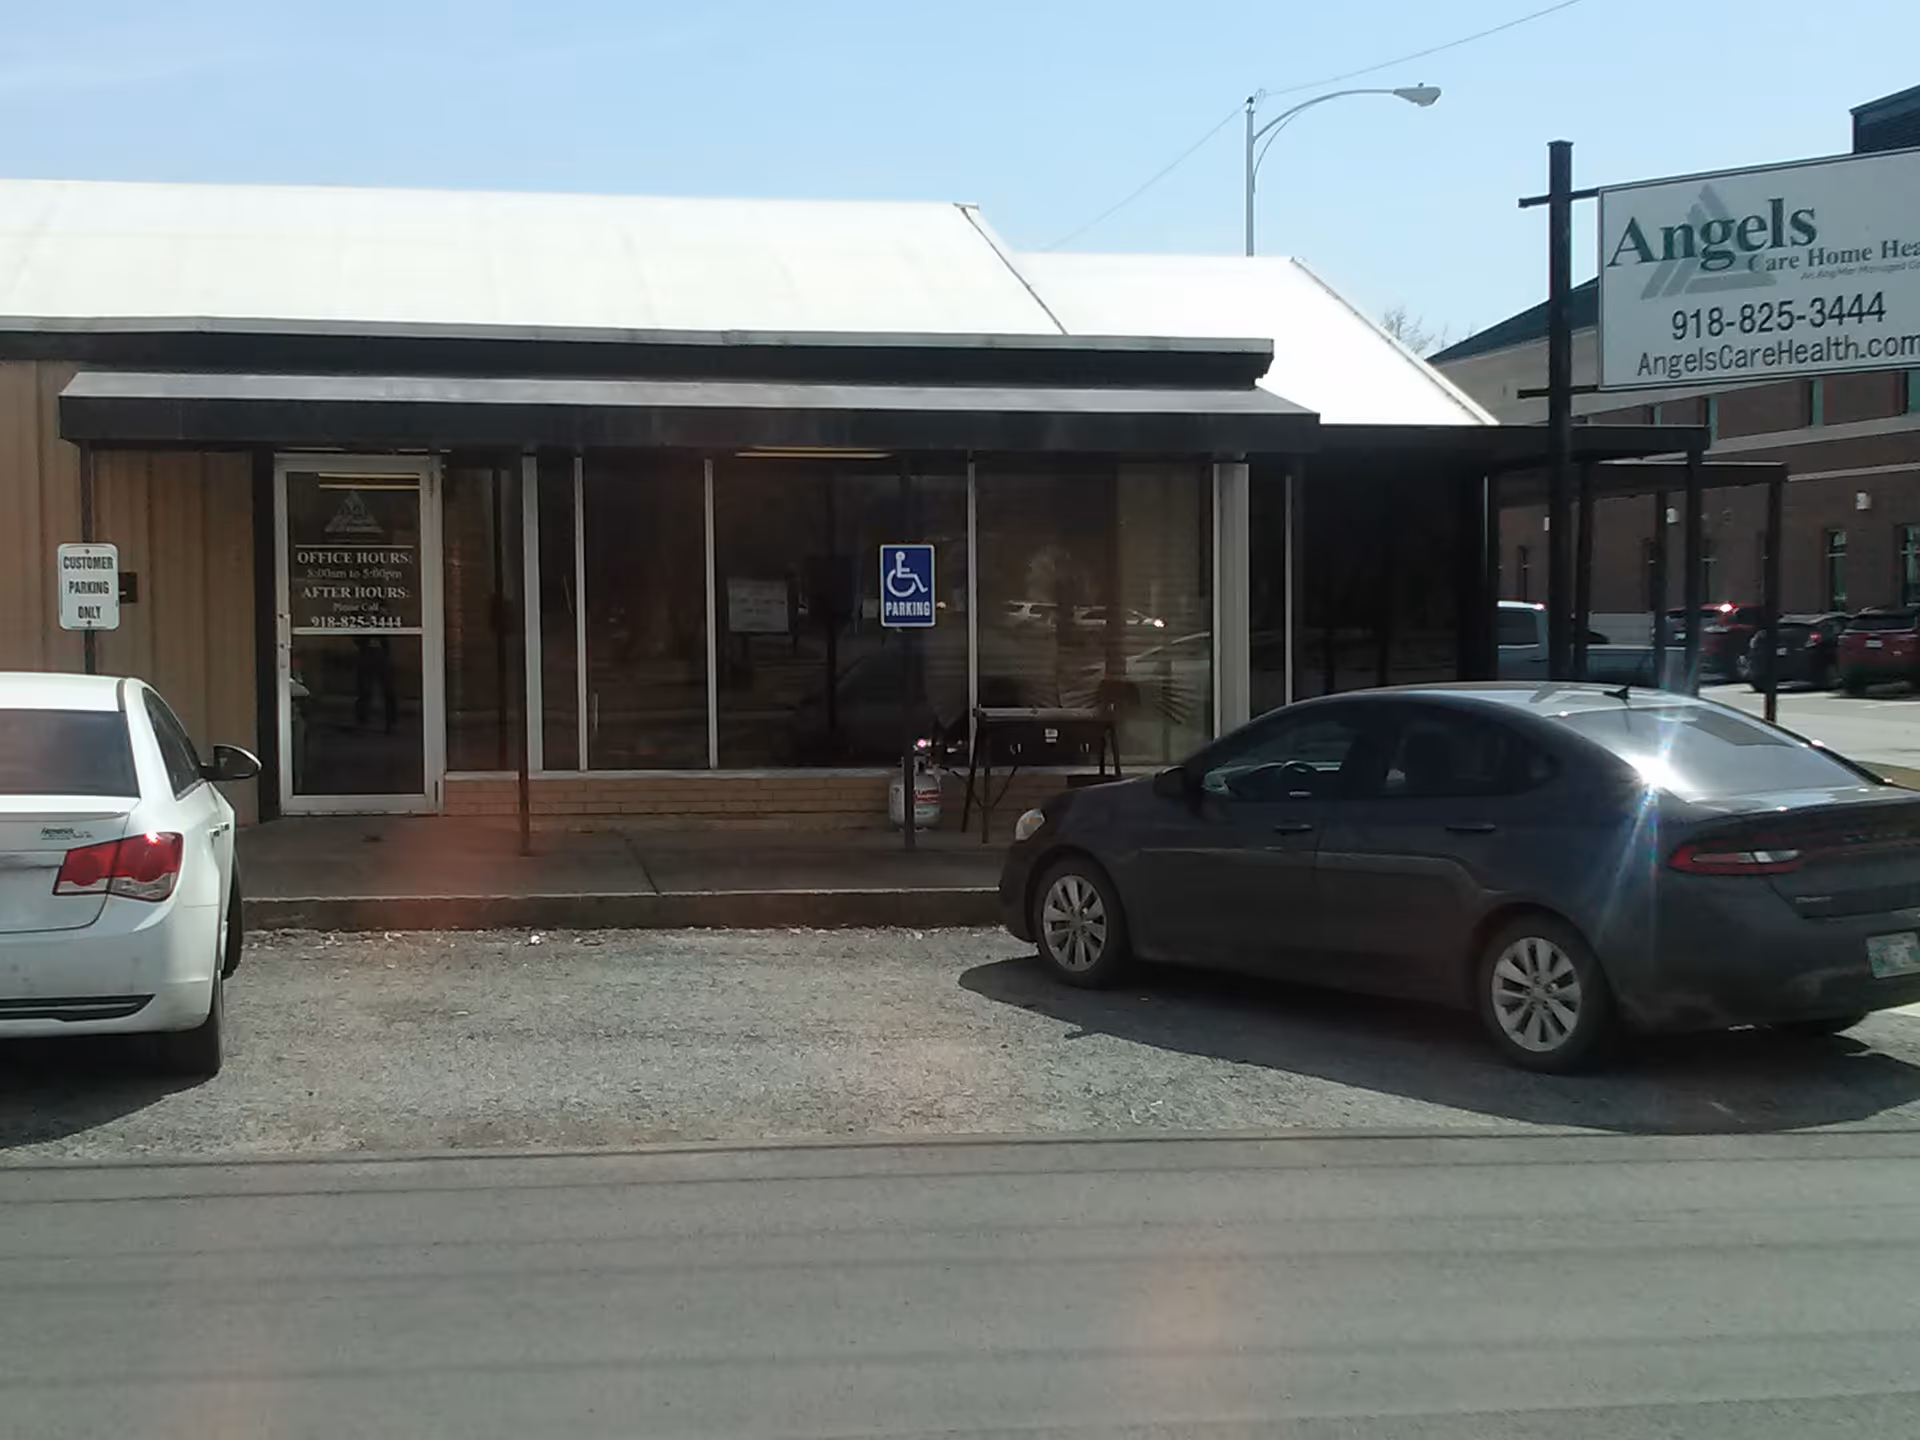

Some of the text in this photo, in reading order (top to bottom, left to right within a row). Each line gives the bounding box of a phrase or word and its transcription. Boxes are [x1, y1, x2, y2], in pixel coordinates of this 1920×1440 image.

[1606, 197, 1818, 272] Angels
[1747, 253, 1800, 273] Care
[1807, 247, 1873, 268] Home
[1671, 291, 1888, 341] 918-825-3444
[1637, 334, 1920, 379] AngelsCareHealth.com
[63, 556, 114, 570] CUSTOMER
[297, 552, 353, 564] OFFICE
[349, 568, 361, 579] to
[362, 568, 403, 581] 5:00pm
[68, 580, 110, 595] PARKING
[303, 586, 352, 599] AFTER
[77, 605, 102, 619] ONLY
[885, 601, 931, 617] PARKING
[310, 615, 403, 629] 918-825-3444
